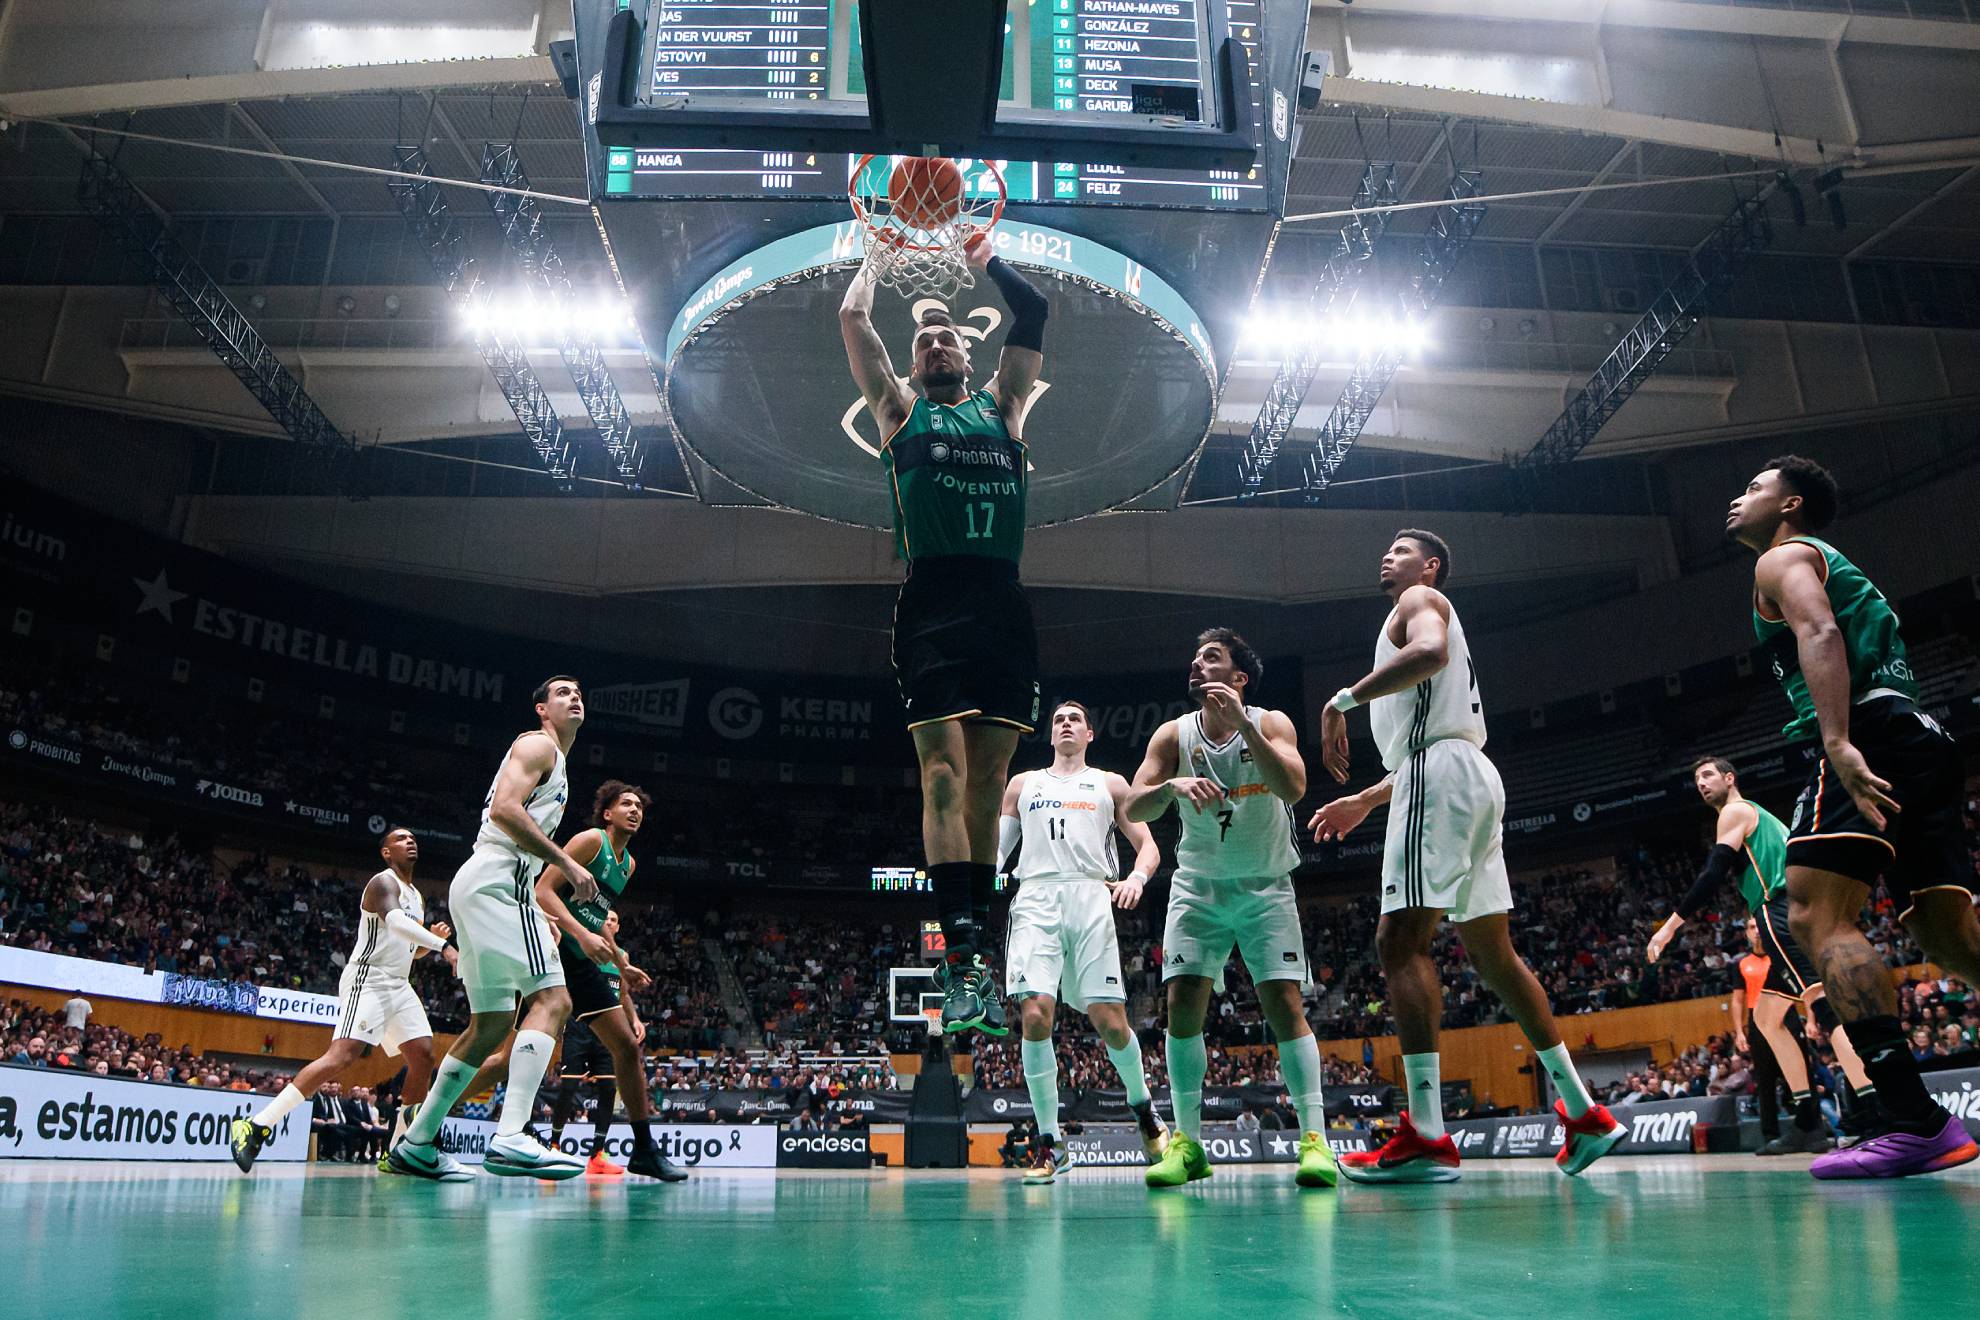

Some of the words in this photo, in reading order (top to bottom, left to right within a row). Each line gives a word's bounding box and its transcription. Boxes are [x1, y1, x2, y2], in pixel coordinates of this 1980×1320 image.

[1084, 0, 1180, 15] RATHAN-MAYES
[1084, 18, 1150, 33] GONZÁLEZ
[674, 31, 699, 42] DER
[701, 31, 752, 42] VUURST
[1057, 39, 1071, 49] 11
[1084, 39, 1141, 52] HEZONJA
[810, 52, 819, 62] 6
[1057, 57, 1073, 69] 13
[1085, 59, 1122, 72] MUSA
[809, 72, 819, 83] 2
[1057, 77, 1073, 89] 14
[1085, 79, 1118, 91] DECK
[637, 154, 683, 167] HANGA
[806, 154, 815, 167] 4
[1057, 181, 1074, 193] 24
[1086, 182, 1121, 195] FELIZ
[1019, 229, 1073, 263] 1921
[952, 449, 1013, 471] PROBITAS
[933, 471, 1017, 496] JOVENTUT
[966, 501, 995, 539] 17
[192, 596, 381, 680] ESTRELLA
[386, 650, 505, 703] DAMM
[779, 696, 872, 723] KERN
[779, 723, 871, 741] PHARMA
[1028, 800, 1097, 811] AUTOHERO
[299, 805, 350, 824] ESTRELLA
[1508, 813, 1557, 833] ESTRELLA
[1047, 817, 1065, 841] 11
[1217, 809, 1234, 842] 7
[725, 861, 767, 878] TCL
[923, 933, 946, 951] 12
[1349, 1093, 1383, 1107] TCL
[37, 1091, 180, 1146] estamos
[607, 1129, 723, 1166] cotigo
[782, 1133, 867, 1153] endesa
[1067, 1140, 1088, 1152] City
[1090, 1140, 1101, 1151] of
[1200, 1138, 1253, 1159] FOLS
[1292, 1138, 1368, 1154] EELLA
[1067, 1150, 1146, 1164] BADALONA
